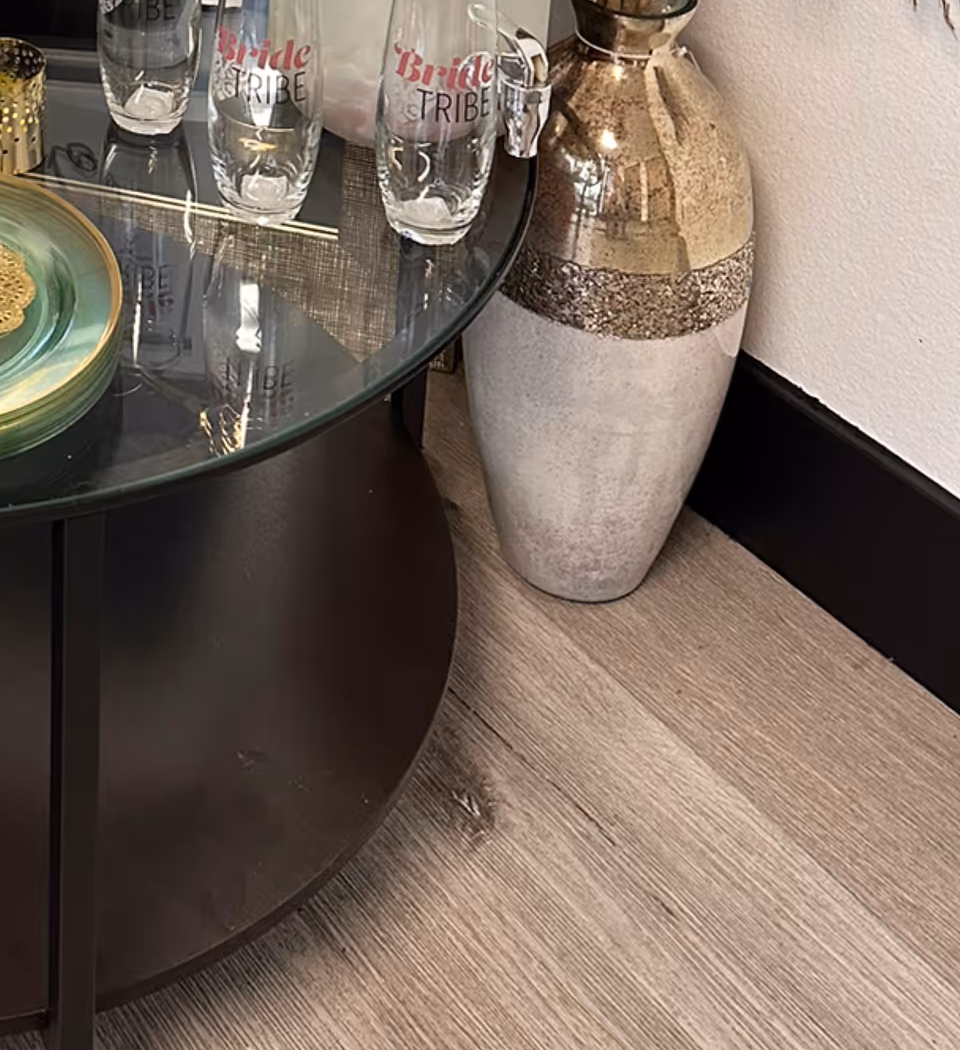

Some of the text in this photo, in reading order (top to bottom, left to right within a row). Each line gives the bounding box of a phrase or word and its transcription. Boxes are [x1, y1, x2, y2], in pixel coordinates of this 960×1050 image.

[217, 23, 311, 71] Bride
[394, 43, 494, 89] Bride
[231, 66, 307, 105] TRIBE
[416, 86, 492, 124] TRIBE
